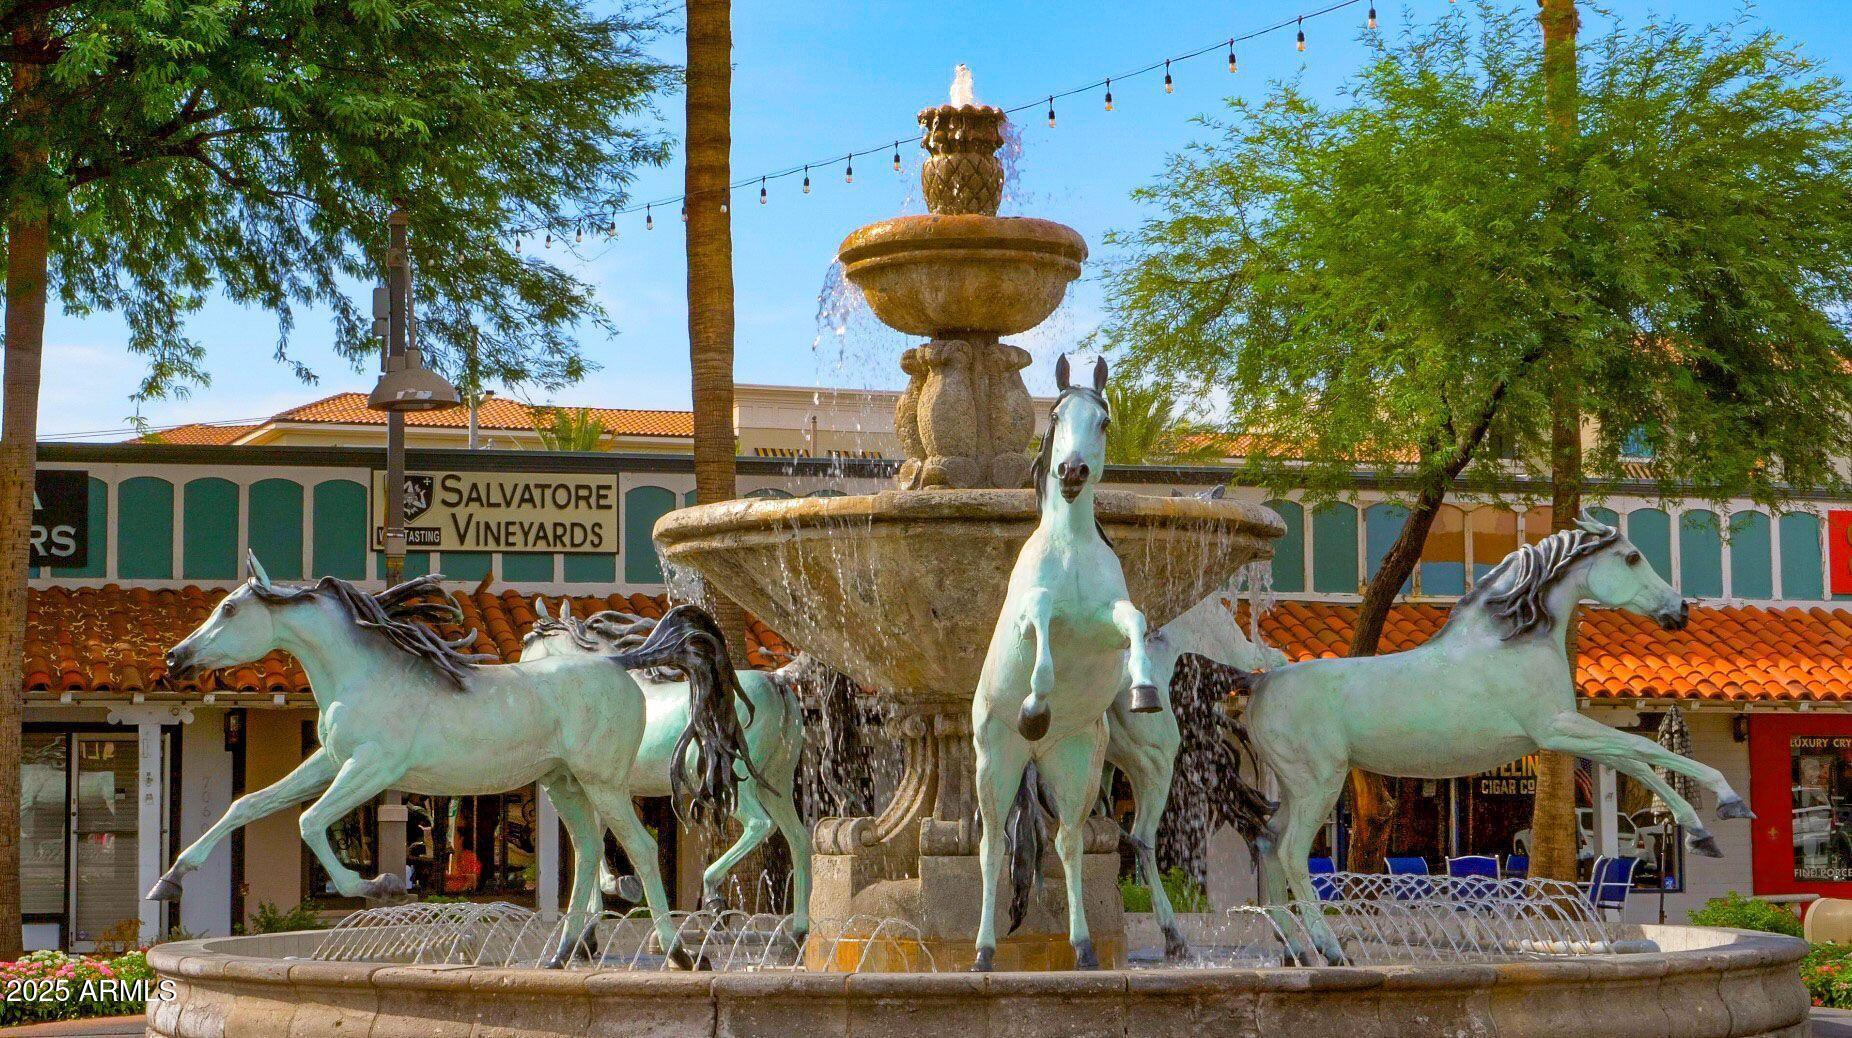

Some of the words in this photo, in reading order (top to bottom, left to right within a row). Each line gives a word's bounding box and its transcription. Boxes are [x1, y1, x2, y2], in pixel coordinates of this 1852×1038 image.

[441, 474, 613, 510] SALVATORE
[404, 530, 440, 543] TASTING
[451, 513, 603, 548] VINEYARDS
[1790, 738, 1829, 748] LUXURY
[1481, 779, 1516, 795] CIGAR
[1794, 868, 1817, 878] FINE
